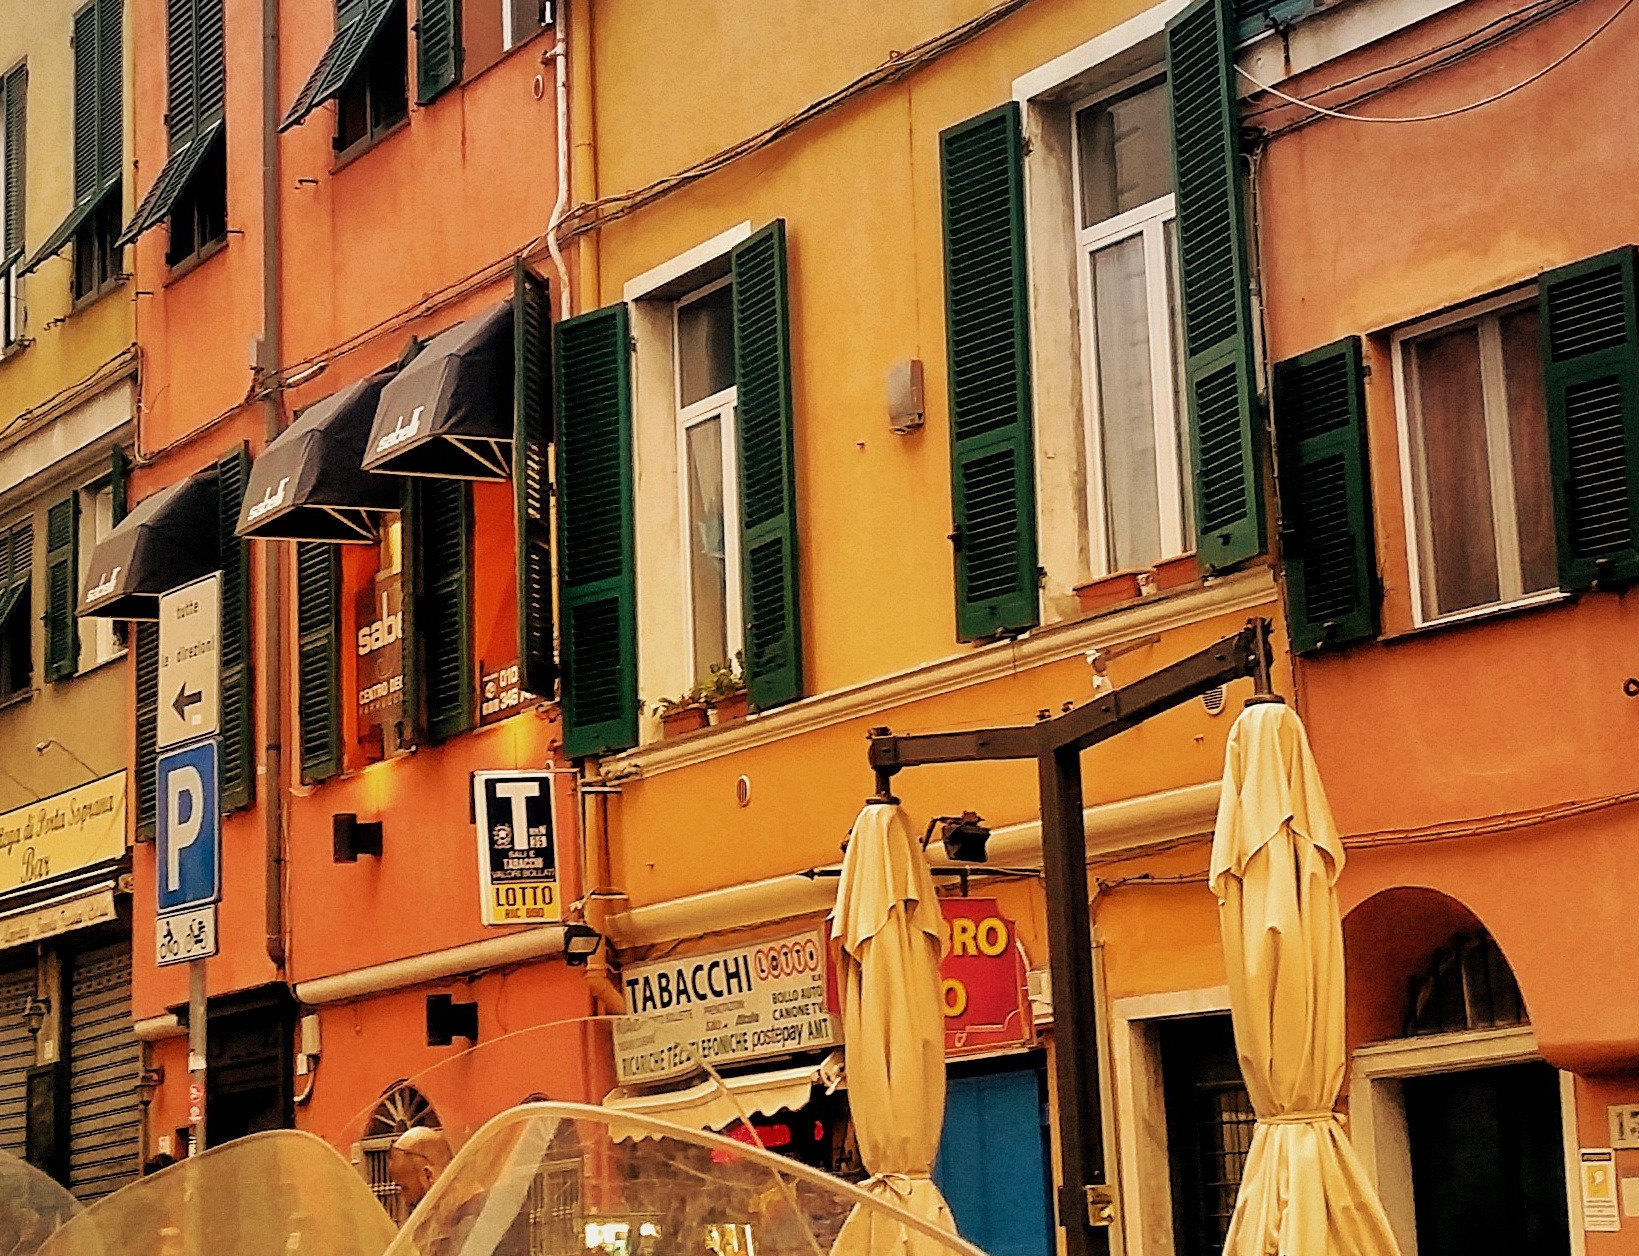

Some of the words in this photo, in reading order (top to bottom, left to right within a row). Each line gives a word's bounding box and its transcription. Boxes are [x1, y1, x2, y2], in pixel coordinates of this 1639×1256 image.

[168, 768, 203, 891] P
[495, 782, 541, 850] T
[20, 846, 50, 883] Bar
[495, 886, 553, 907] LOTTO
[953, 917, 1009, 956] RO
[626, 954, 752, 1014] TABACCHI
[756, 941, 818, 980] LOTTO
